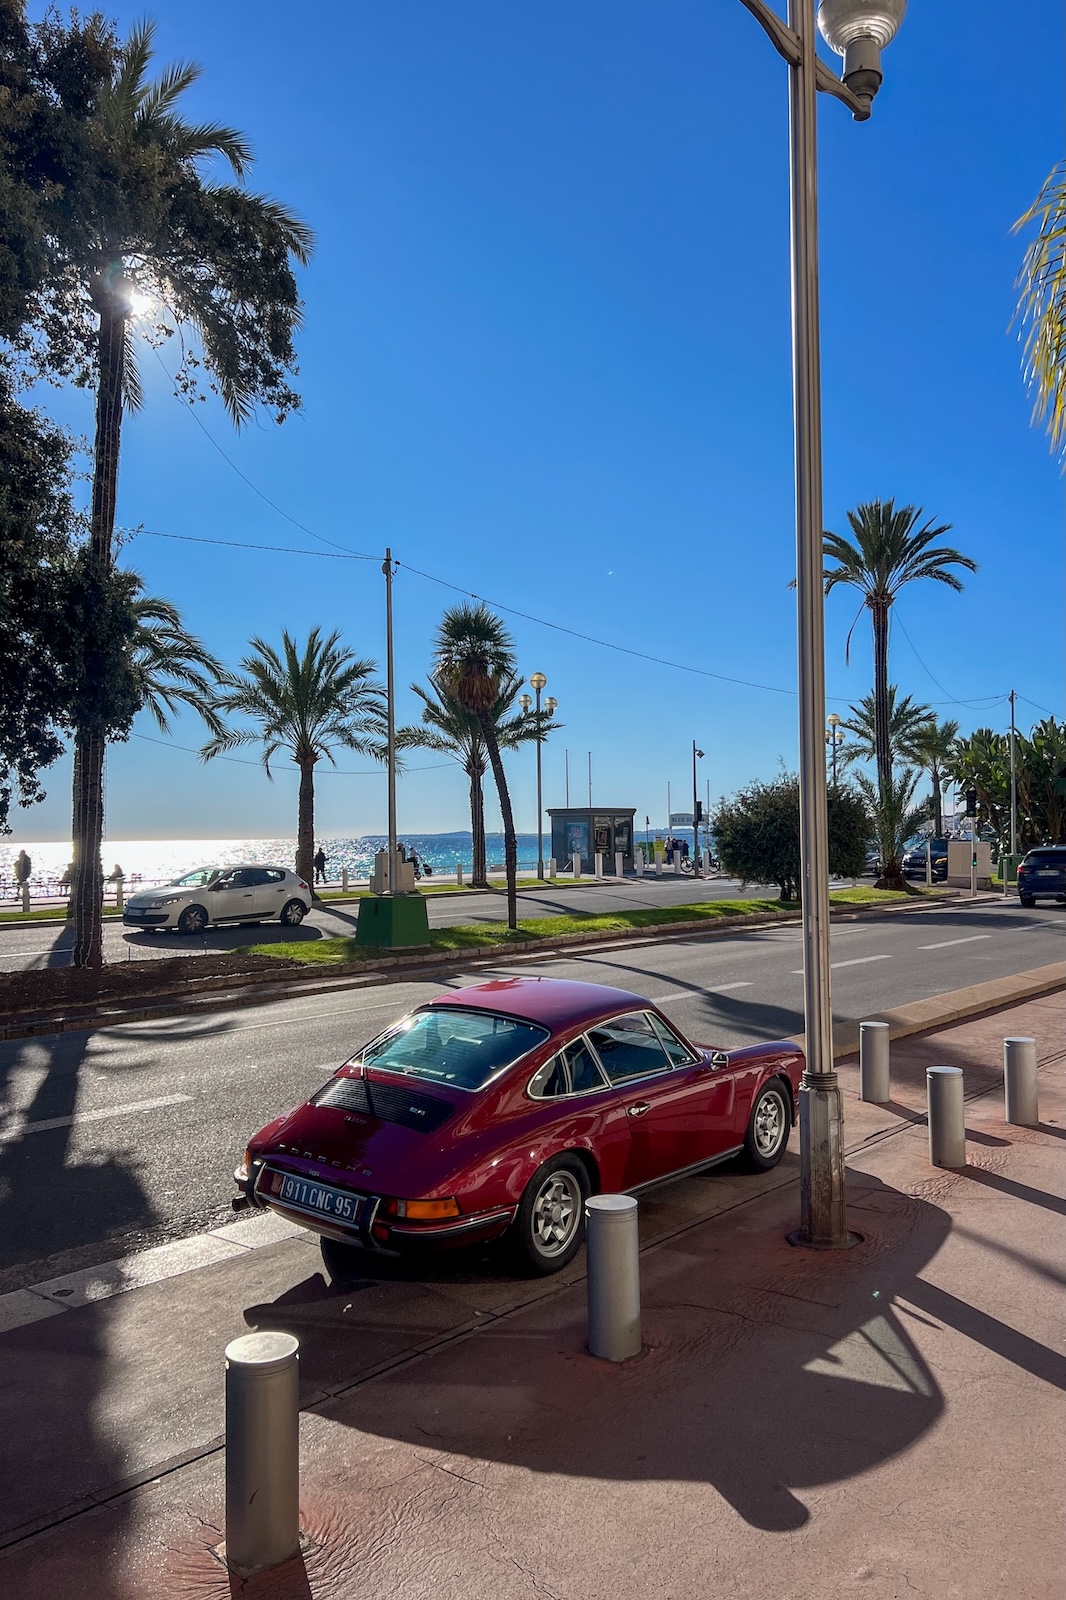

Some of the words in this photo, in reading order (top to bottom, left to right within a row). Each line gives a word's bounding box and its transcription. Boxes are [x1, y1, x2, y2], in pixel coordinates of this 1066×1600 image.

[278, 1143, 372, 1177] PORSCHE
[286, 1180, 308, 1203] 911
[309, 1188, 334, 1211] CNC
[335, 1196, 352, 1217] 95
